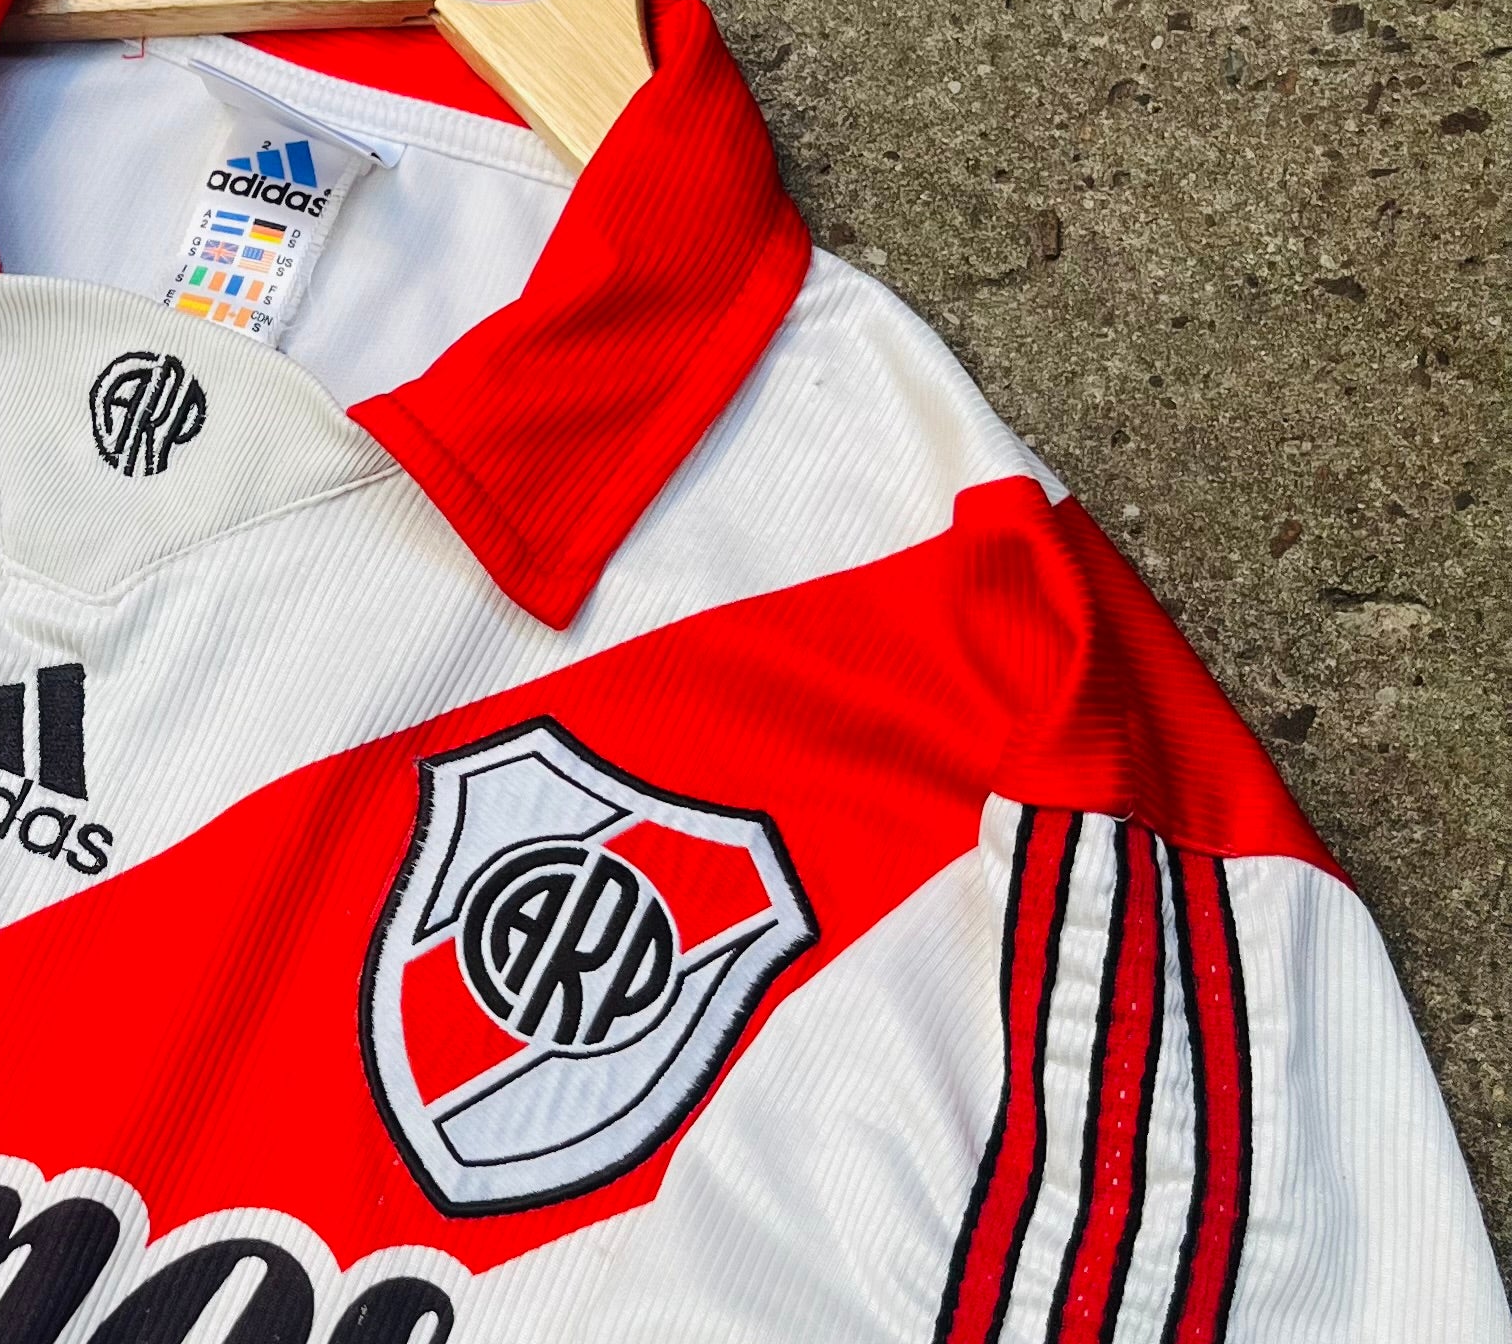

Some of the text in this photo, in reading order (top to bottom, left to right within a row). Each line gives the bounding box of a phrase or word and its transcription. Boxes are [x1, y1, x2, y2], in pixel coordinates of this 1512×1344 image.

[207, 170, 327, 218] adidas
[203, 209, 212, 219] A
[291, 229, 301, 239] D
[287, 239, 297, 249] S
[188, 247, 197, 257] S
[276, 255, 294, 268] US
[276, 267, 285, 277] S
[175, 273, 185, 283] S
[166, 289, 177, 299] E
[268, 285, 278, 294] F
[263, 295, 273, 306] S
[250, 310, 274, 326] CDN
[251, 322, 262, 333] S
